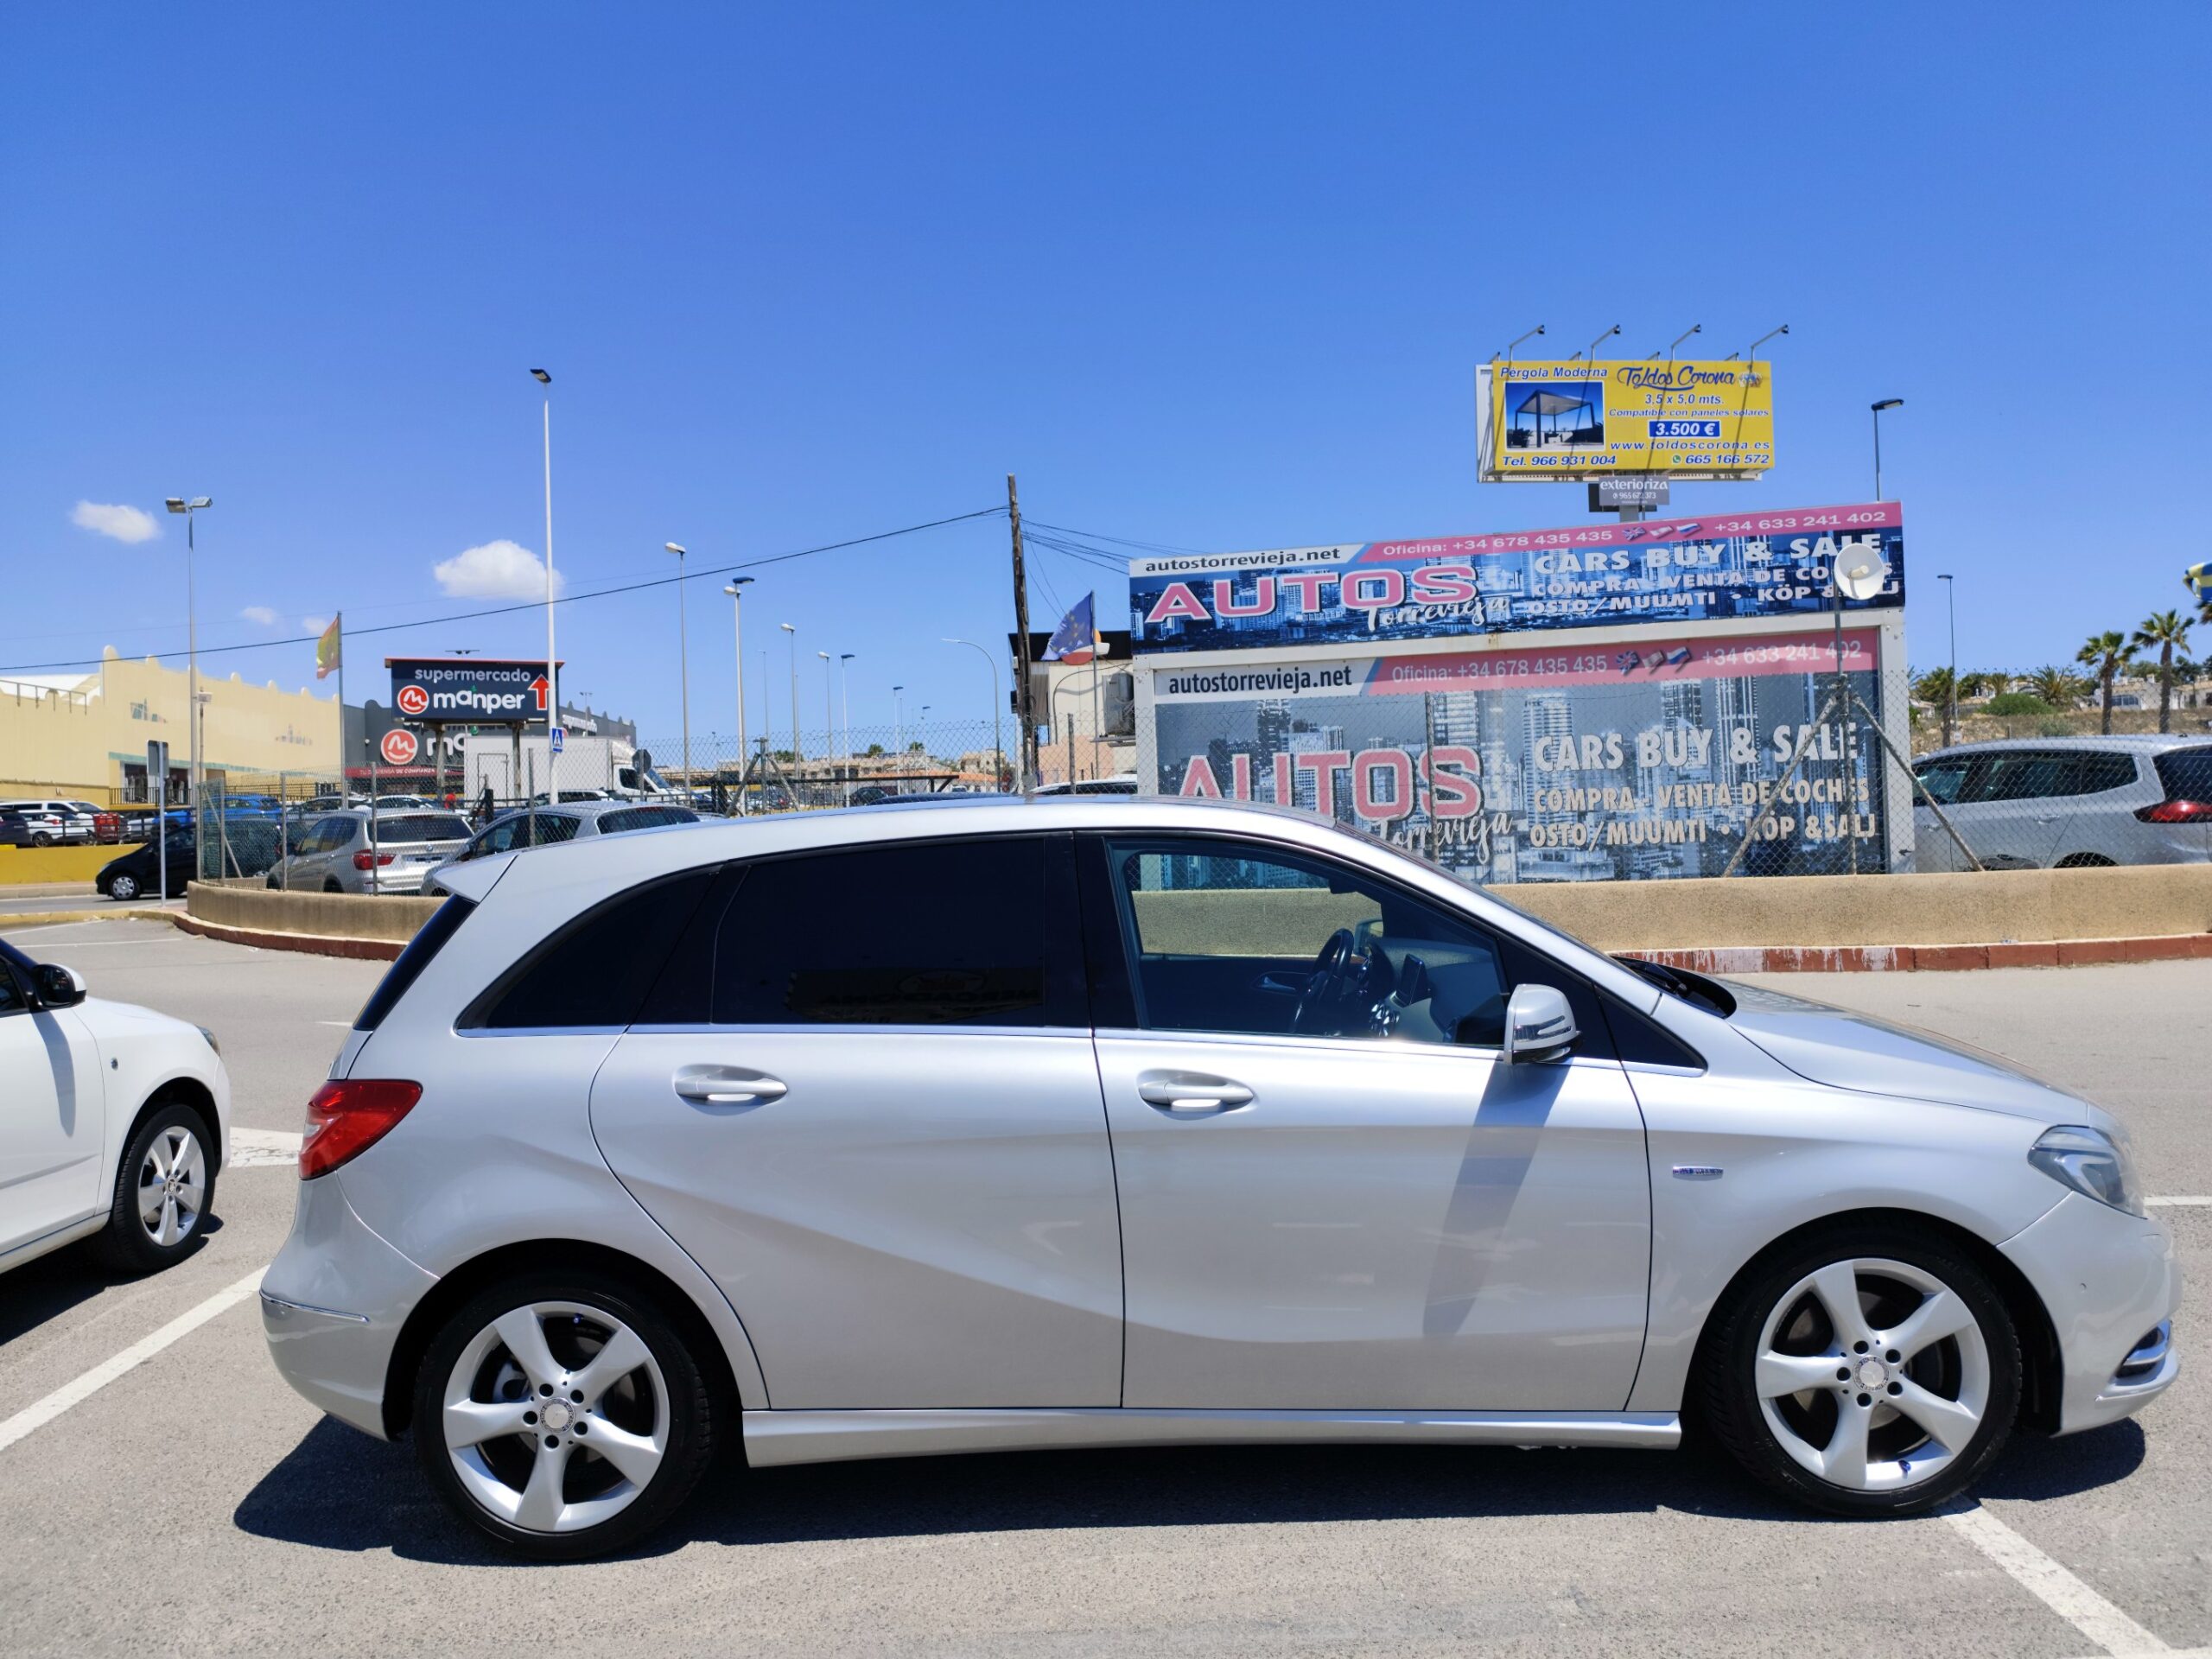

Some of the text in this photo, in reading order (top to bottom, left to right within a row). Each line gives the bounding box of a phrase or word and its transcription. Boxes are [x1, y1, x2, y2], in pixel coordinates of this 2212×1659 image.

[1553, 367, 1607, 377] Moderna
[1617, 365, 1735, 388] Toldos Corona
[1645, 394, 1724, 404] 3,5 x 5,0 mts.
[1609, 408, 1666, 418] Compatible
[1691, 409, 1730, 418] paneles
[1656, 423, 1715, 435] 3.500 €
[1610, 440, 1770, 450] www.toldoscorona.es
[1503, 455, 1616, 466] Tel. 966 931 004
[1686, 454, 1769, 464] 665 166 572
[1599, 478, 1669, 490] exterioriza
[1715, 512, 1886, 532] +34 633 241 402
[1383, 531, 1612, 556] Oficina: +34 678 435 435
[1145, 548, 1341, 573] autostorrevieja.net
[1535, 550, 1630, 575] CARS
[1646, 543, 1726, 568] BUY
[1744, 541, 1773, 562] &
[1534, 577, 1638, 596] COMPRA
[1667, 571, 1747, 589] VENTA
[1755, 569, 1786, 583] DE
[1758, 584, 1811, 601] KÖP
[1144, 565, 1478, 623] AUTOS
[1360, 595, 1510, 632] Torrevieja
[1702, 648, 1737, 665] +34
[1744, 645, 1780, 664] 633
[1785, 643, 1820, 662] 241
[414, 668, 531, 683] supermercado
[1169, 665, 1352, 694] autostorrevieja.net
[1392, 655, 1606, 683] Oficina: +34 678 435 435
[433, 690, 525, 715] manper
[1535, 721, 1858, 772] CARS BUY & SALE
[1534, 786, 1636, 813] COMPRA
[1658, 782, 1732, 809] VENTA
[1741, 780, 1771, 805] DE
